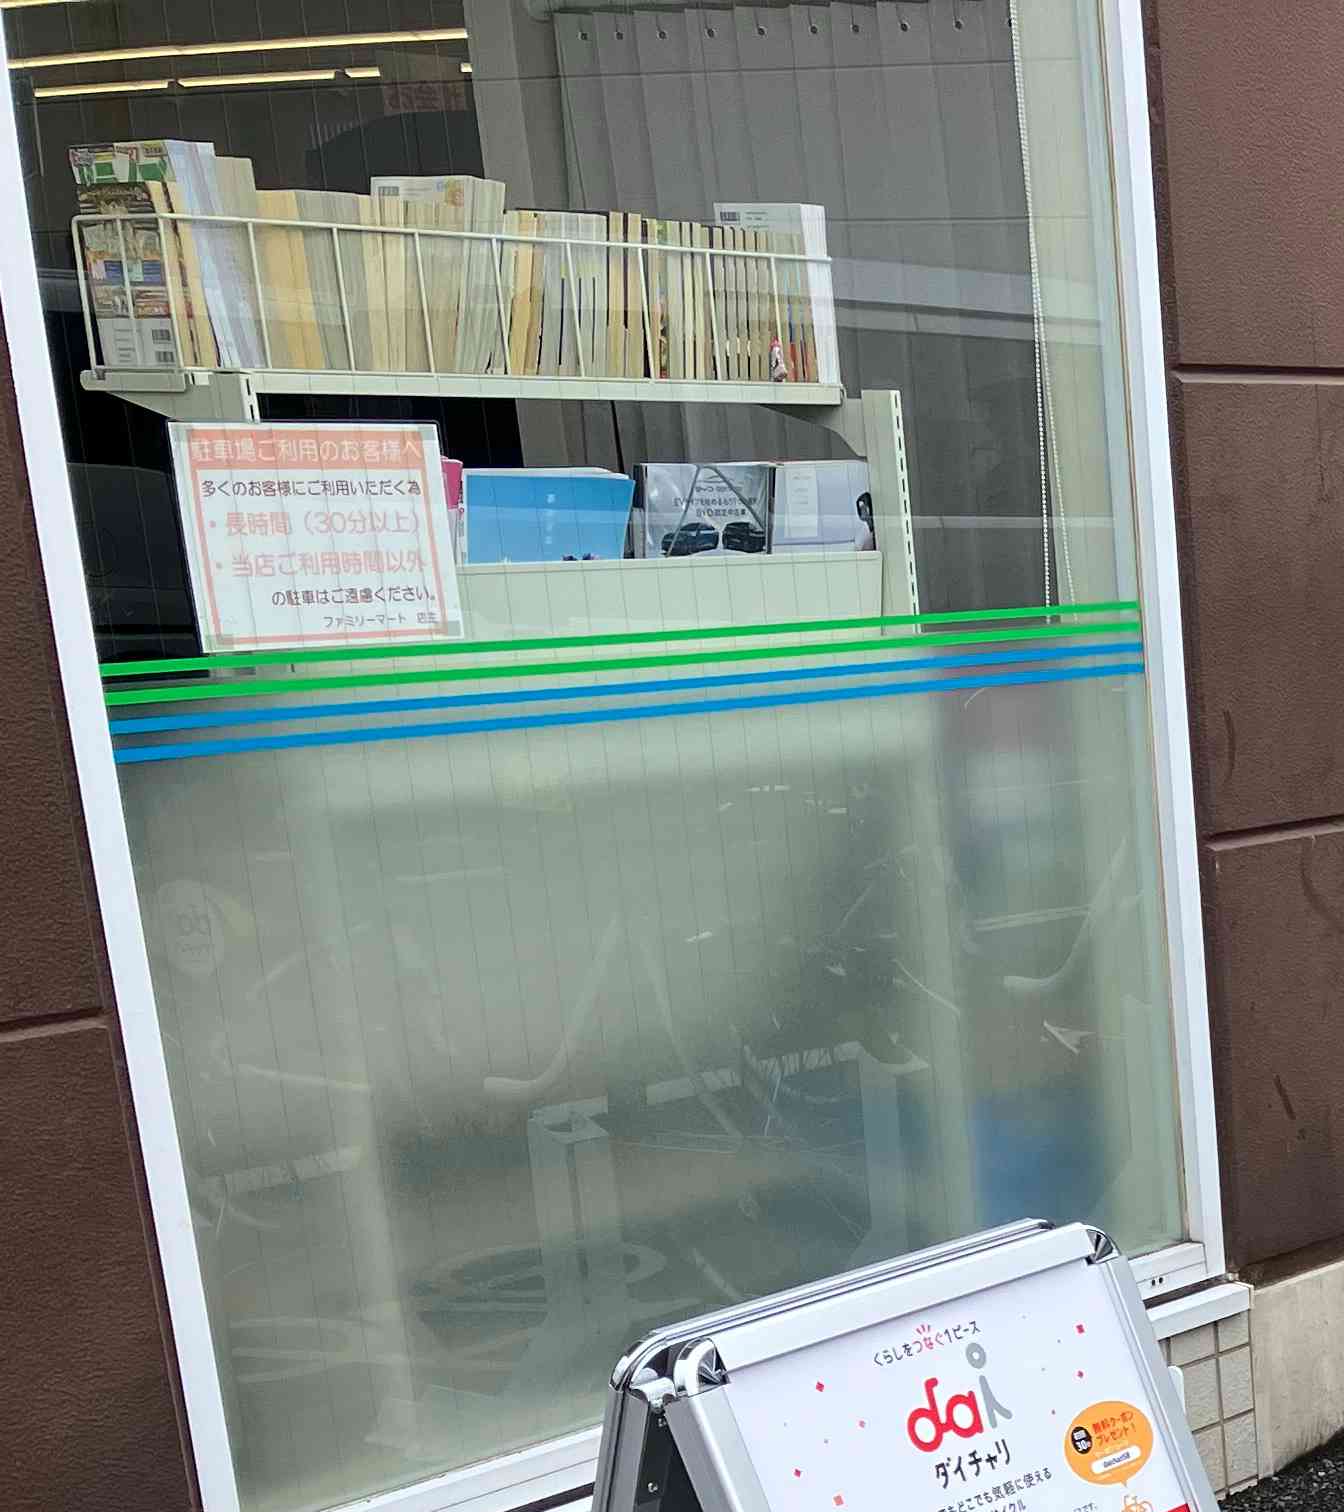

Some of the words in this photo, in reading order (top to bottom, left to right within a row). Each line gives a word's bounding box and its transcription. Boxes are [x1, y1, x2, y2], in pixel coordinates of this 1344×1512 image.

[191, 439, 422, 461] 駐車場ご利用のお客様へ
[201, 480, 421, 497] 多くのお客様にご利用いただく為
[271, 587, 436, 606] の駐車はご遠慮ください。
[323, 615, 406, 627] ファミリーマート
[873, 1321, 982, 1367] くらしをつなぐ1ピース
[907, 1342, 1013, 1452] dai
[935, 1439, 1012, 1489] ダイチャリ
